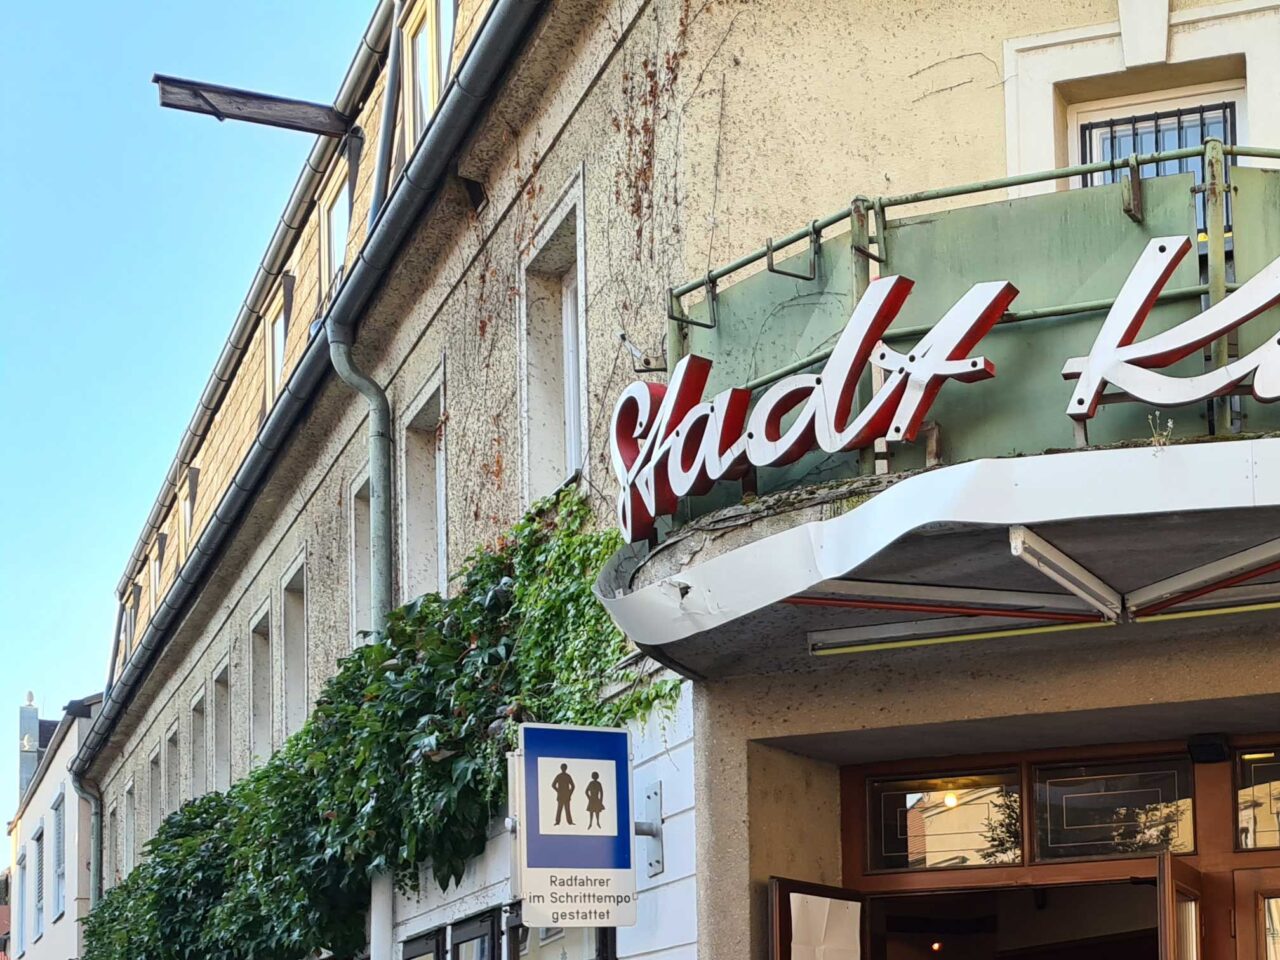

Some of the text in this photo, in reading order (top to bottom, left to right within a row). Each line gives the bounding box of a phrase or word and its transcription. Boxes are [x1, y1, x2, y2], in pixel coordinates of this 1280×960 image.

[609, 274, 1019, 544] Stadt
[549, 875, 611, 887] Radfahrer
[528, 891, 631, 906] im Schritttempo
[551, 909, 610, 923] gestattet
